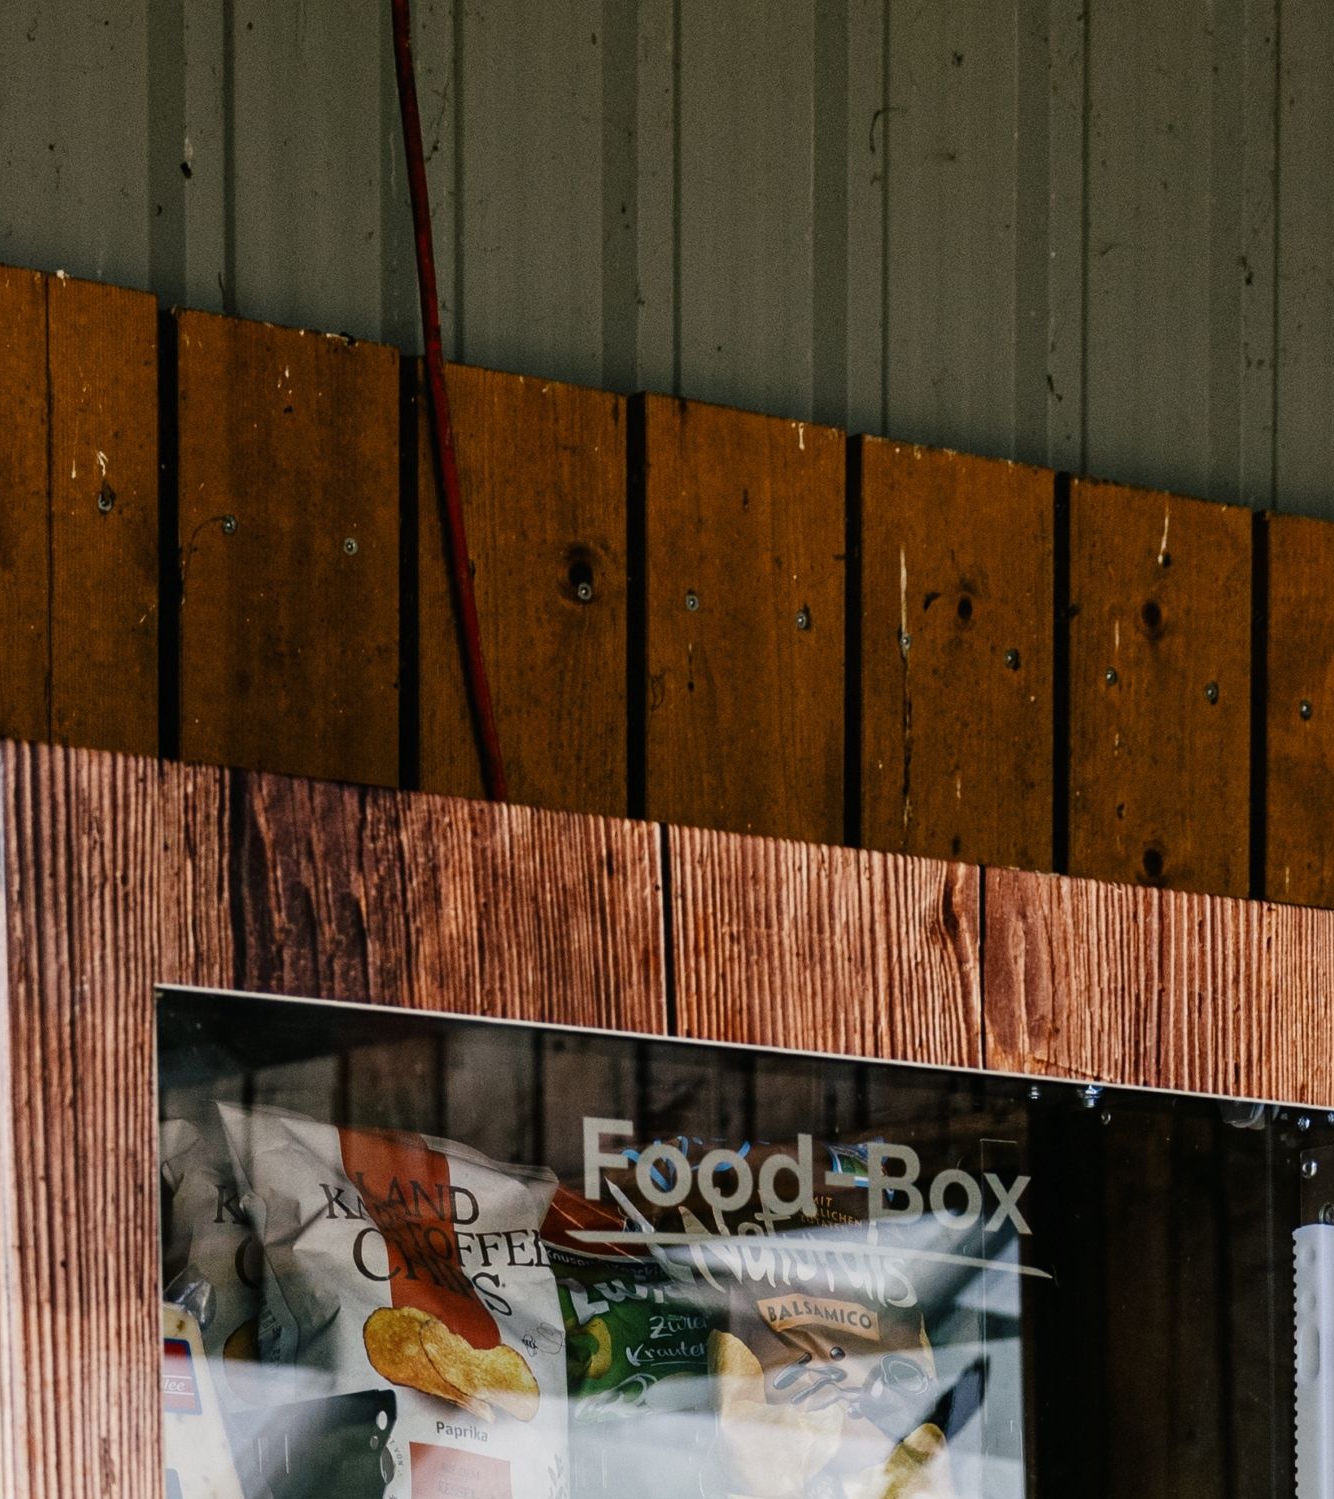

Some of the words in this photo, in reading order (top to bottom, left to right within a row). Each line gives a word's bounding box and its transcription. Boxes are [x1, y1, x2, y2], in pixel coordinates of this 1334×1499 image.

[582, 1116, 1033, 1235] Food-Box
[767, 1300, 872, 1329] BALSAMICO
[436, 1421, 489, 1442] Paprika
